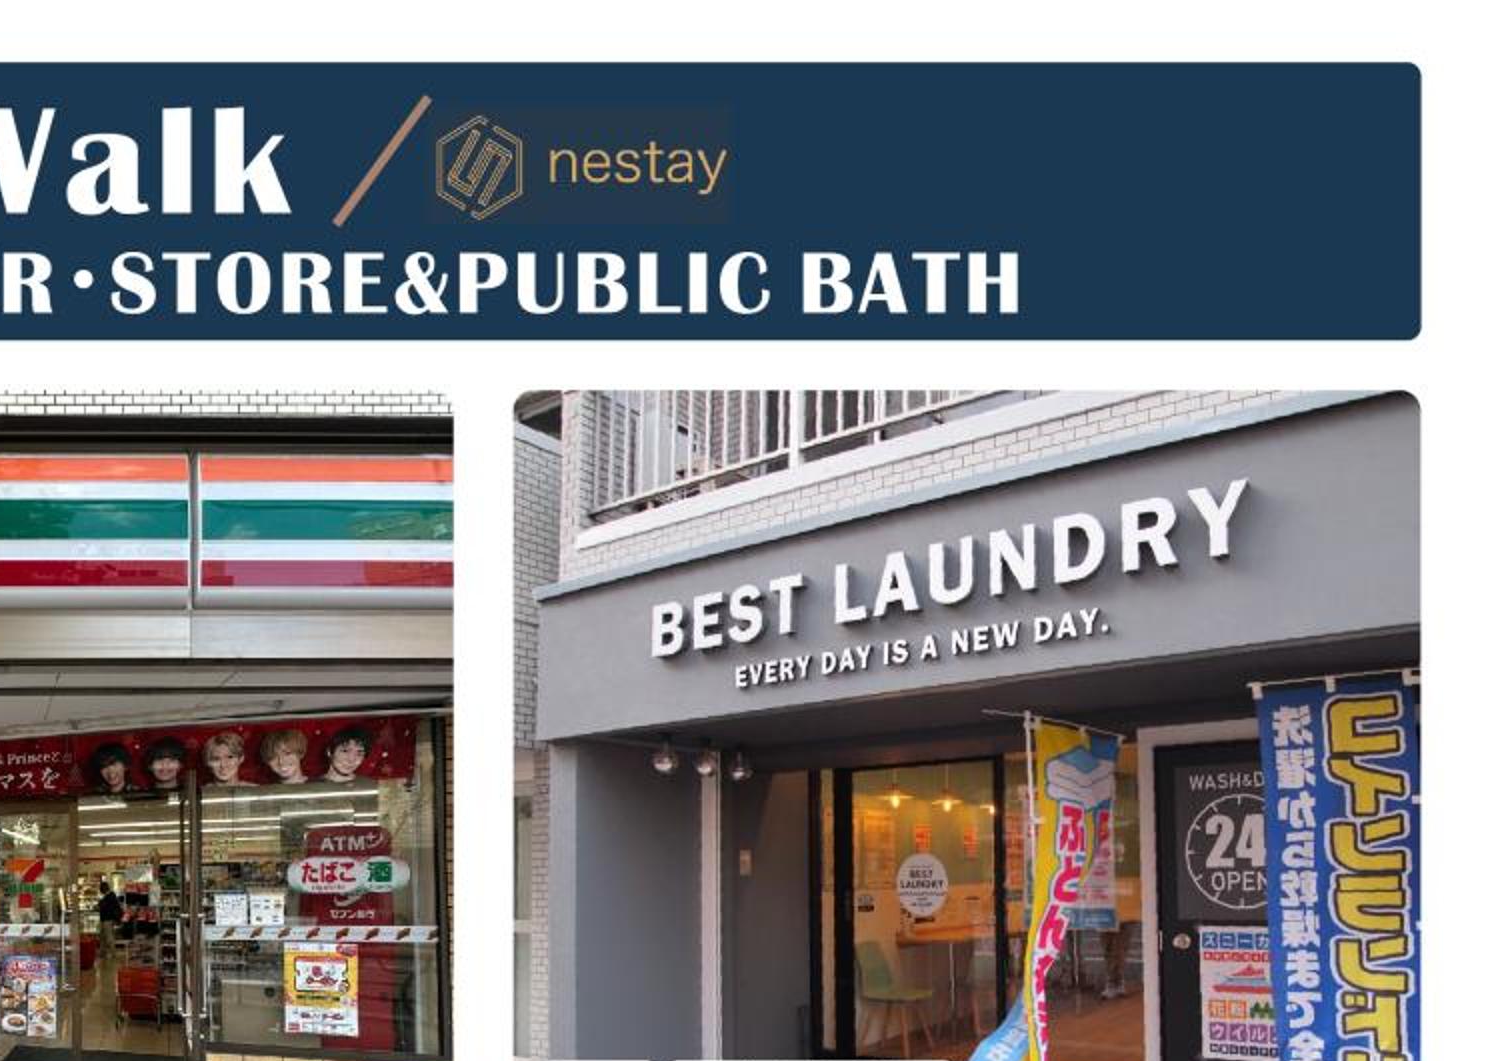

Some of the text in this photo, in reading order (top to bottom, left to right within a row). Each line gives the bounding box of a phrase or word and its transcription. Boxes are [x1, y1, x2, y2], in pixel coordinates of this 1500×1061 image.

[650, 478, 1250, 660] BEST LAUNDRY
[734, 652, 812, 690] EVERY
[821, 640, 873, 678] DAY
[882, 636, 910, 667] IS
[921, 631, 940, 661] A
[951, 621, 1019, 656] NEW
[1188, 771, 1266, 791] WASH&D
[301, 861, 393, 884] たばこ 酒
[1211, 872, 1268, 892] OPEN
